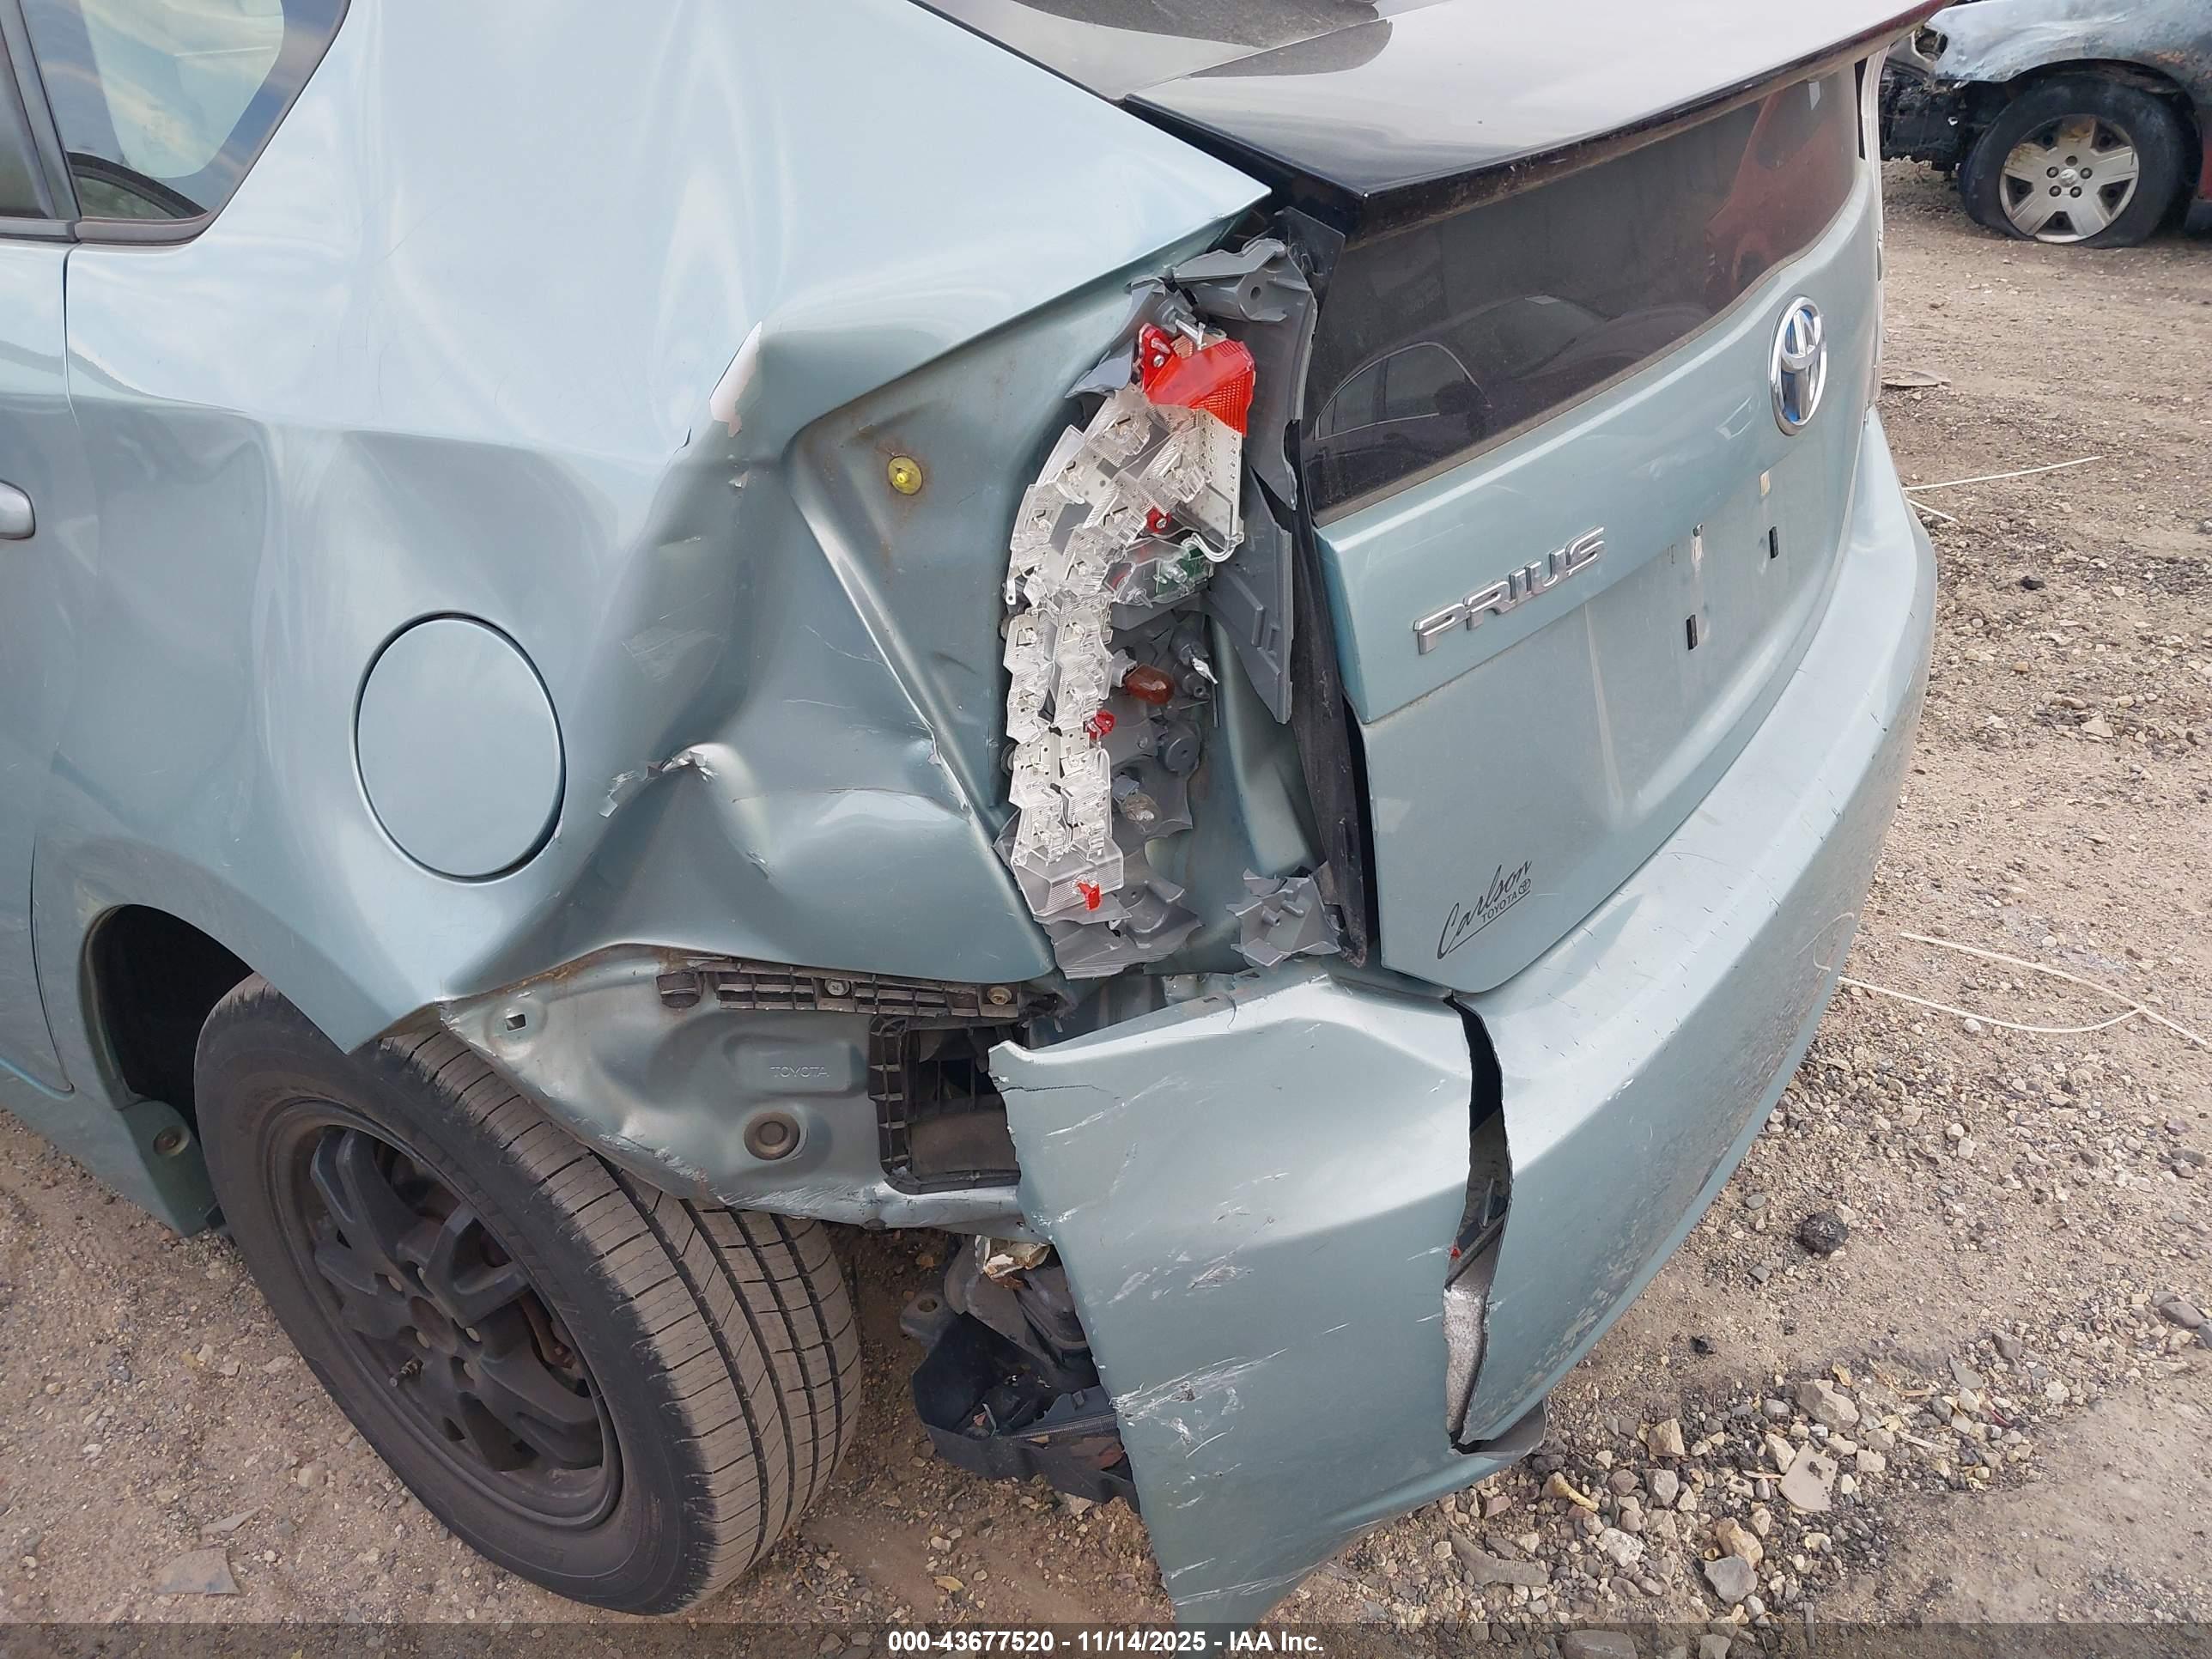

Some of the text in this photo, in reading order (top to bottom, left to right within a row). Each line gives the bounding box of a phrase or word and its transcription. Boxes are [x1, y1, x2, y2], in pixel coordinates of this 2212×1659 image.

[1412, 525, 1606, 655] PRIUS
[1437, 860, 1533, 960] Carlson
[1481, 891, 1517, 923] TOYOTA
[769, 1066, 830, 1079] TOYOTA
